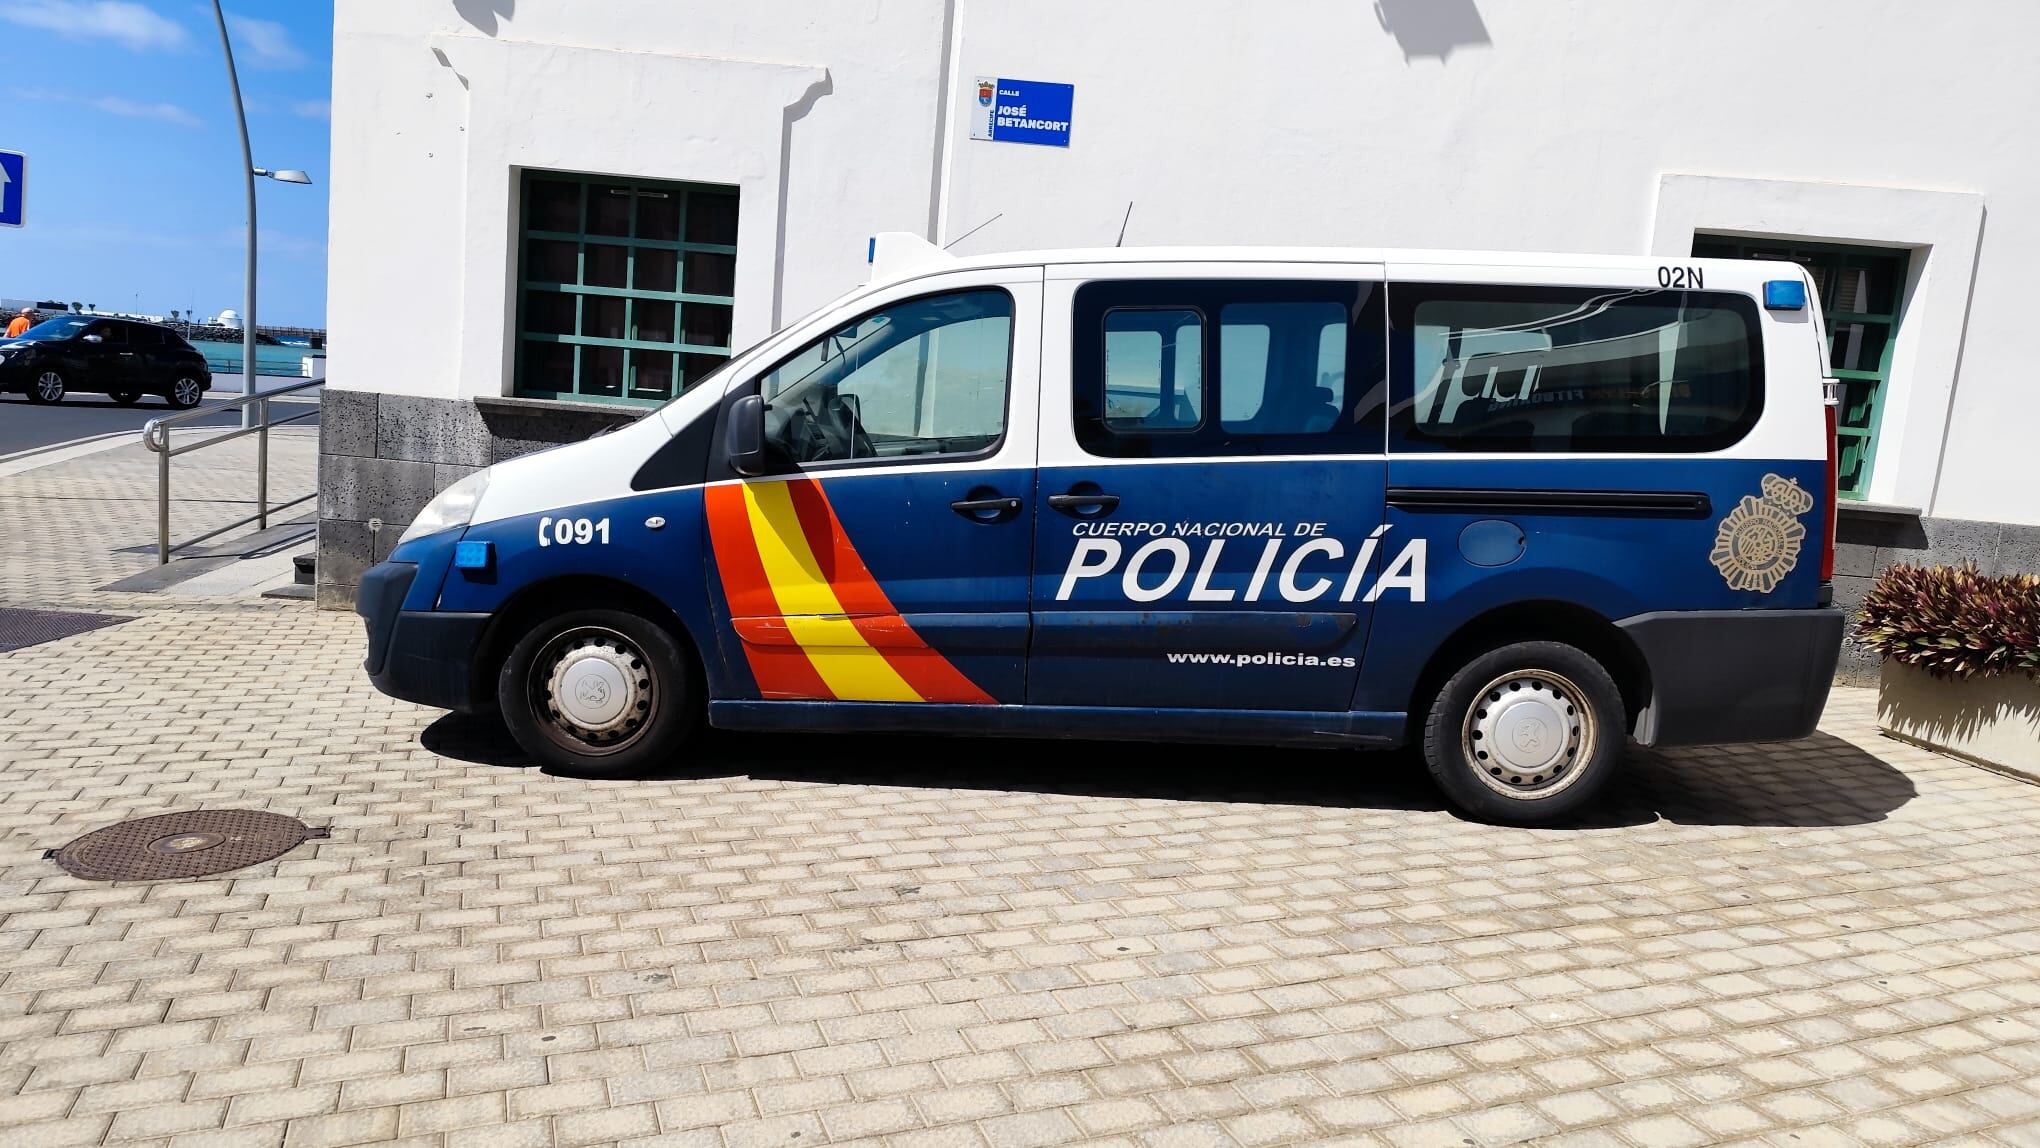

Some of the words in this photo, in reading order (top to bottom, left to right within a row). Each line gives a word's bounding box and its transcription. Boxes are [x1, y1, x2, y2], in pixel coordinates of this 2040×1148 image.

[997, 105, 1027, 117] JOSÉ
[997, 117, 1068, 131] BETANCORT
[1657, 266, 1704, 289] 02N
[554, 518, 610, 545] 091
[1072, 522, 1167, 537] CUERPO
[1171, 522, 1287, 537] NACIONAL
[1294, 522, 1328, 537] DE
[1055, 524, 1428, 603] POLICÍA
[1166, 652, 1357, 668] www.policia.es
